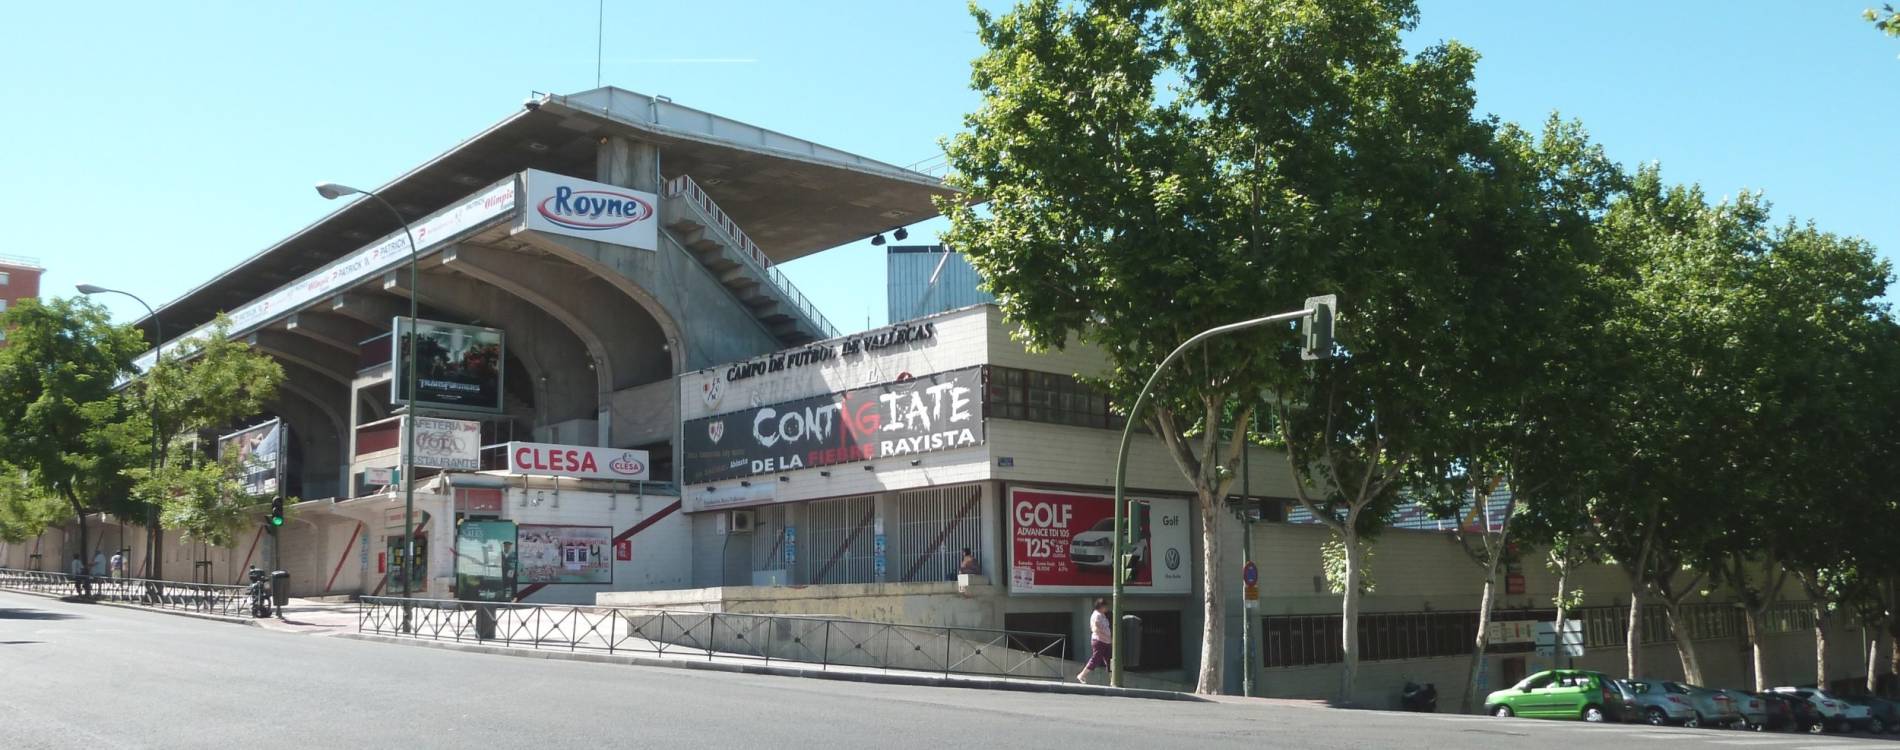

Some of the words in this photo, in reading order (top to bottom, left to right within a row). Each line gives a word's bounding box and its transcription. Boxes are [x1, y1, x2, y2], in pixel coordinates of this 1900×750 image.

[556, 186, 637, 219] Royne
[380, 239, 406, 255] PATRICK
[727, 362, 767, 382] CAMPO
[768, 357, 785, 373] DE
[842, 340, 861, 356] DE
[864, 323, 934, 351] VALLECAS
[515, 447, 598, 472] CLESA
[752, 458, 774, 473] DE
[780, 454, 803, 469] LA
[807, 442, 875, 464] FIEBRE
[881, 429, 975, 456] RAYISTA
[403, 455, 478, 468] RSTAURANTE
[614, 462, 639, 471] CLESA
[1016, 501, 1072, 528] GOLF
[1163, 515, 1179, 526] Golf
[1017, 528, 1049, 537] ADVANCE
[1049, 529, 1059, 537] TDI
